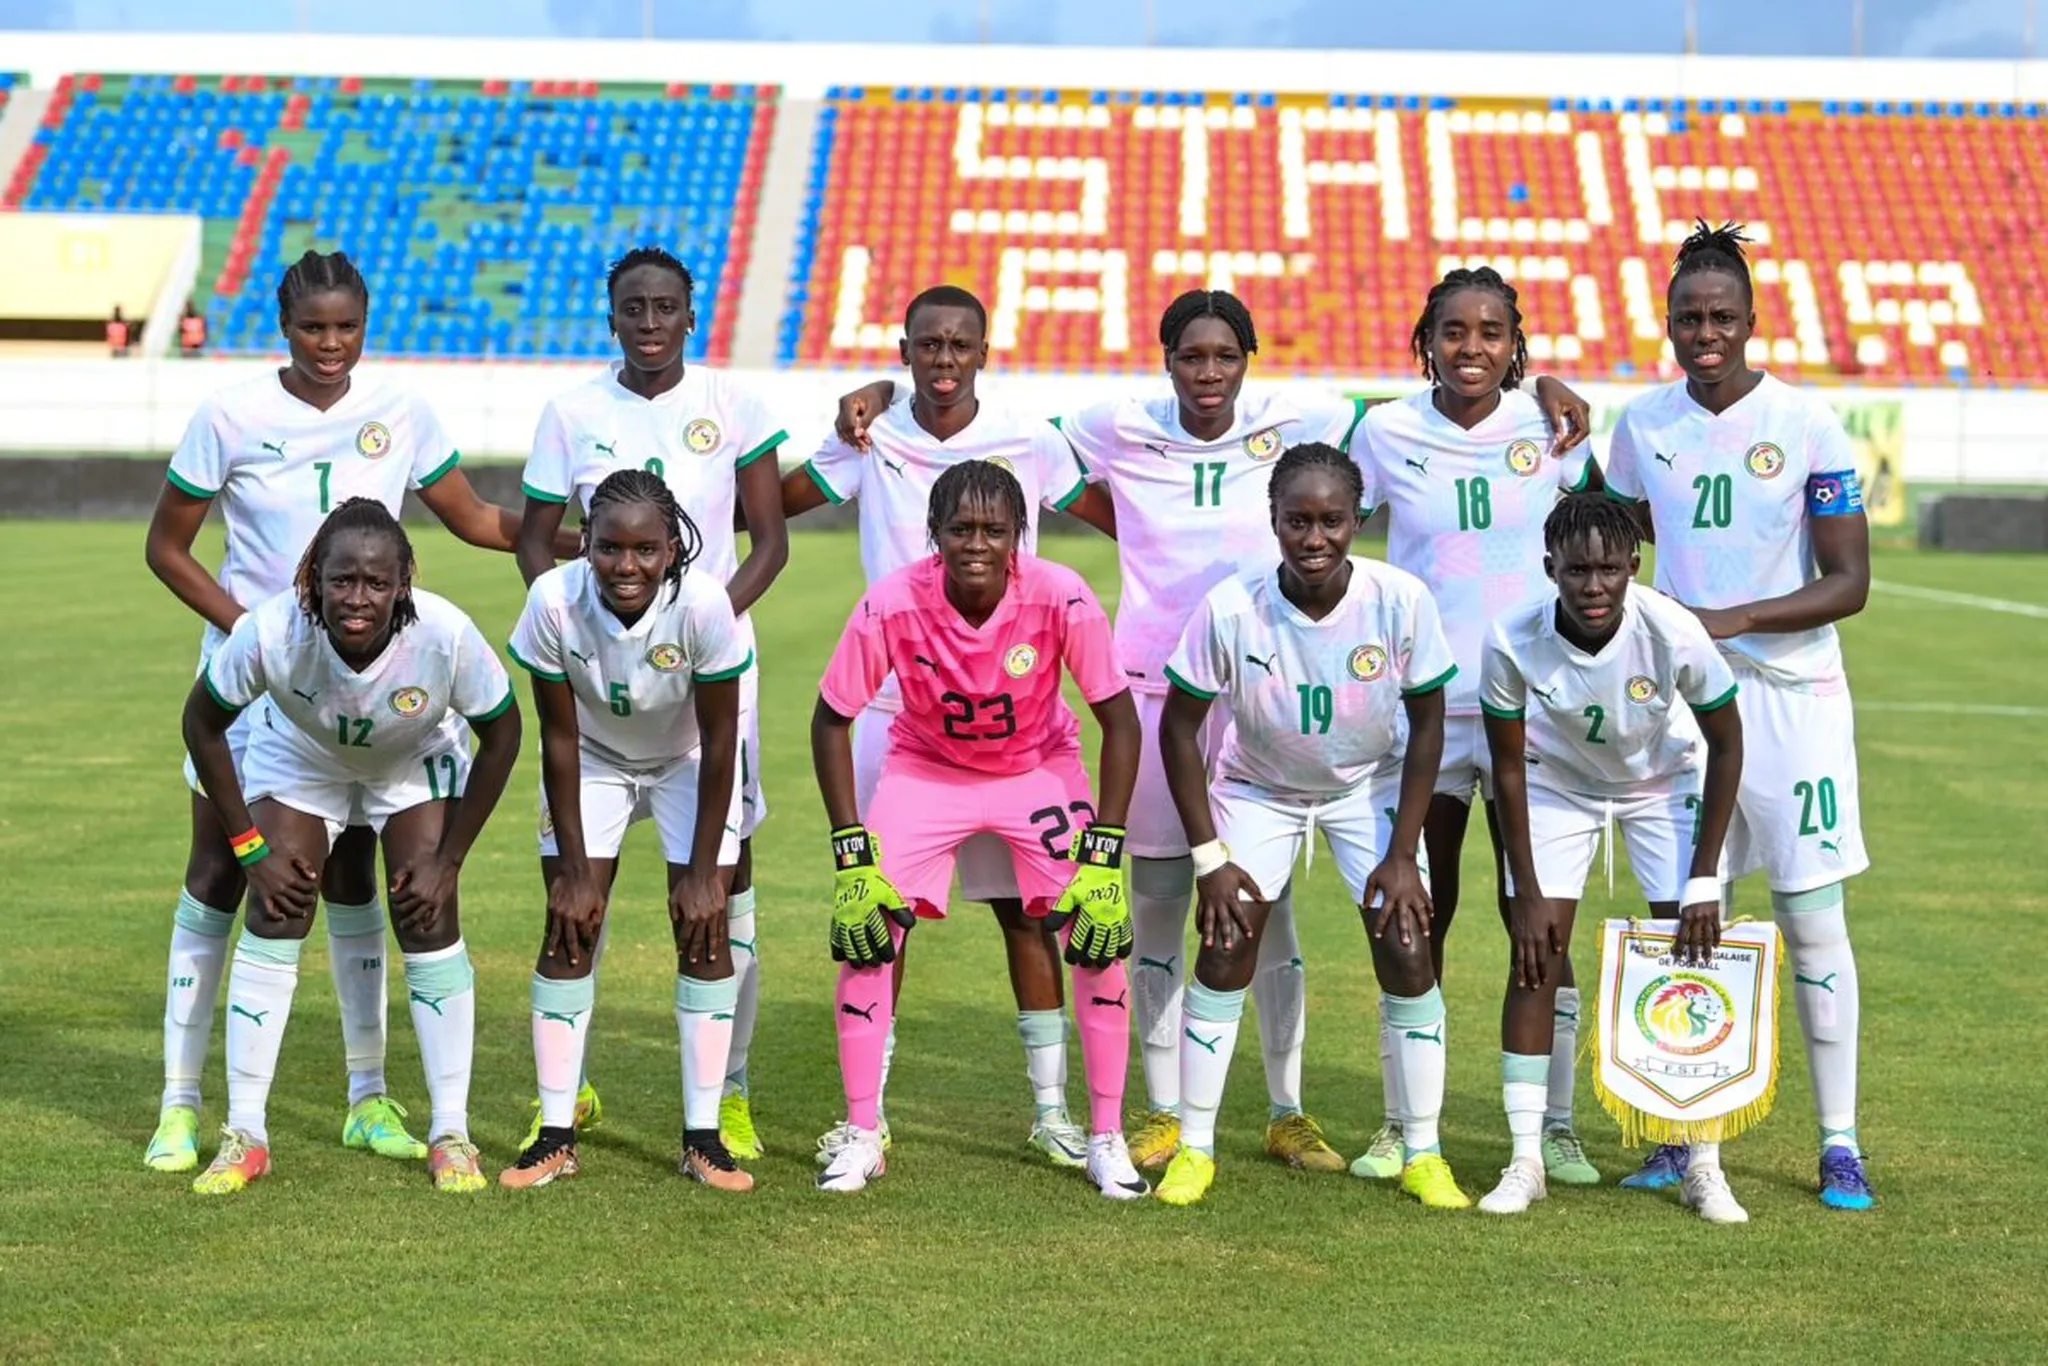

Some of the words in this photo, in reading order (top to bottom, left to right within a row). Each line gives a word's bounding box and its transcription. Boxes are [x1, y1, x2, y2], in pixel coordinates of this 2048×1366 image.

[950, 103, 1772, 245] STADE
[830, 246, 1292, 352] LAT
[313, 461, 331, 513] 7
[1193, 462, 1227, 506] 17
[1455, 476, 1492, 531] 18
[1691, 474, 1732, 529] 20
[610, 682, 631, 717] 5
[941, 691, 1016, 740] 23
[1297, 683, 1333, 735] 19
[1583, 704, 1606, 744] 2
[337, 715, 374, 748] 12
[423, 754, 457, 801] 12
[1794, 777, 1837, 836] 20
